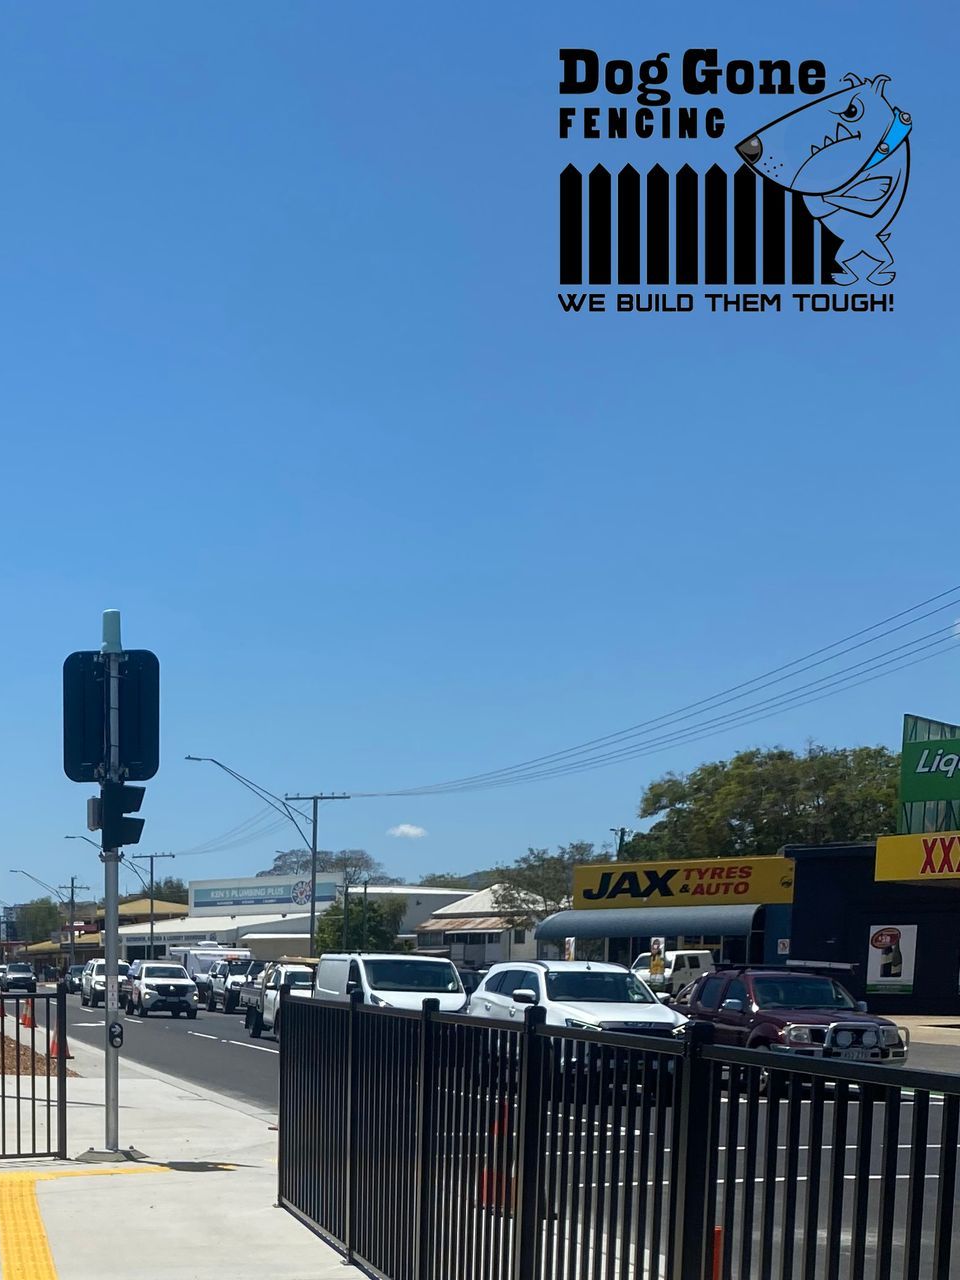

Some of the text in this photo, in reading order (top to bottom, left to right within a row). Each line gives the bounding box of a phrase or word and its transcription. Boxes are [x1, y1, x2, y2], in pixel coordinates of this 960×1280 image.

[915, 748, 960, 778] Liq
[683, 866, 753, 880] TYRES
[583, 869, 680, 900] JAX
[691, 881, 750, 896] AUTO
[231, 888, 266, 898] PLUMBING
[267, 887, 284, 897] PLUS
